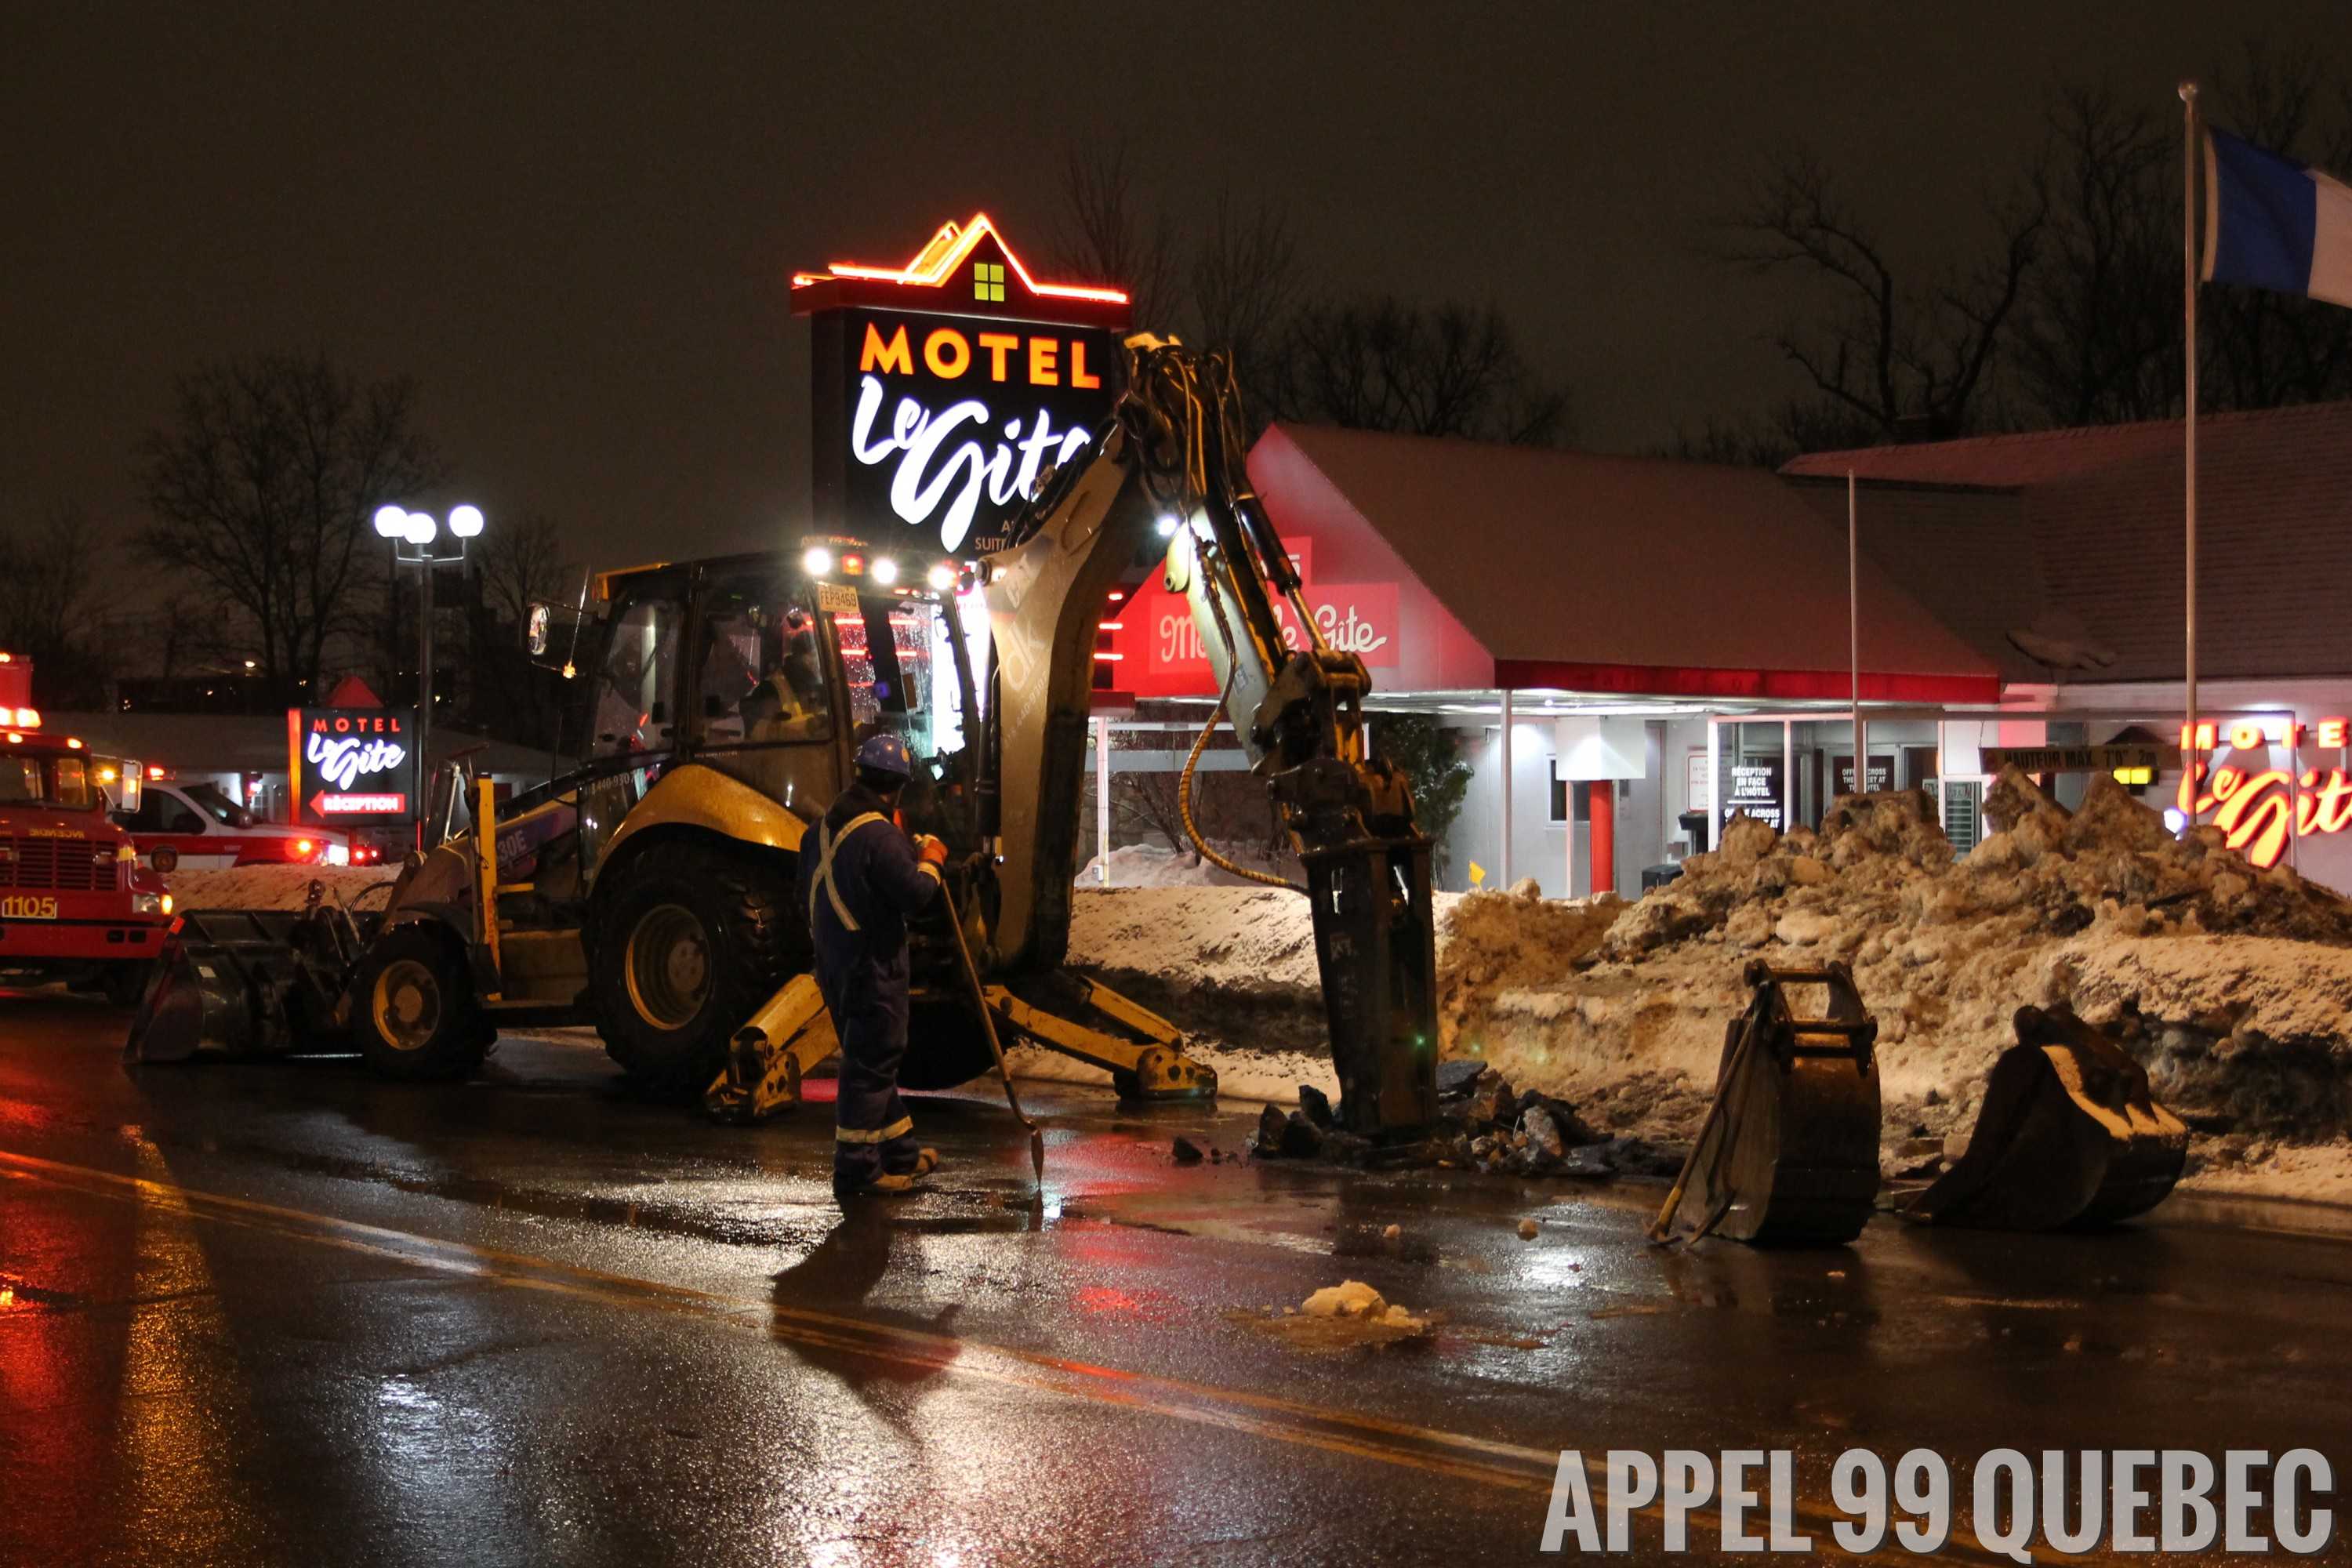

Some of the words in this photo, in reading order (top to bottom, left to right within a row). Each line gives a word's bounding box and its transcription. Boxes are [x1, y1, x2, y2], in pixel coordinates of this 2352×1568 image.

[860, 322, 1100, 389] MOTEL
[852, 375, 931, 465] Le
[314, 719, 401, 732] MOTEL
[307, 732, 338, 764] Le
[1731, 765, 1772, 777] RÉCEPTION
[1736, 777, 1747, 786] EN
[1748, 777, 1766, 786] FACE
[2176, 759, 2247, 816] Le
[323, 795, 398, 811] RÉCEPTION
[1751, 808, 1780, 818] ACROSS
[1769, 818, 1780, 829] AT
[4, 896, 55, 916] 1105
